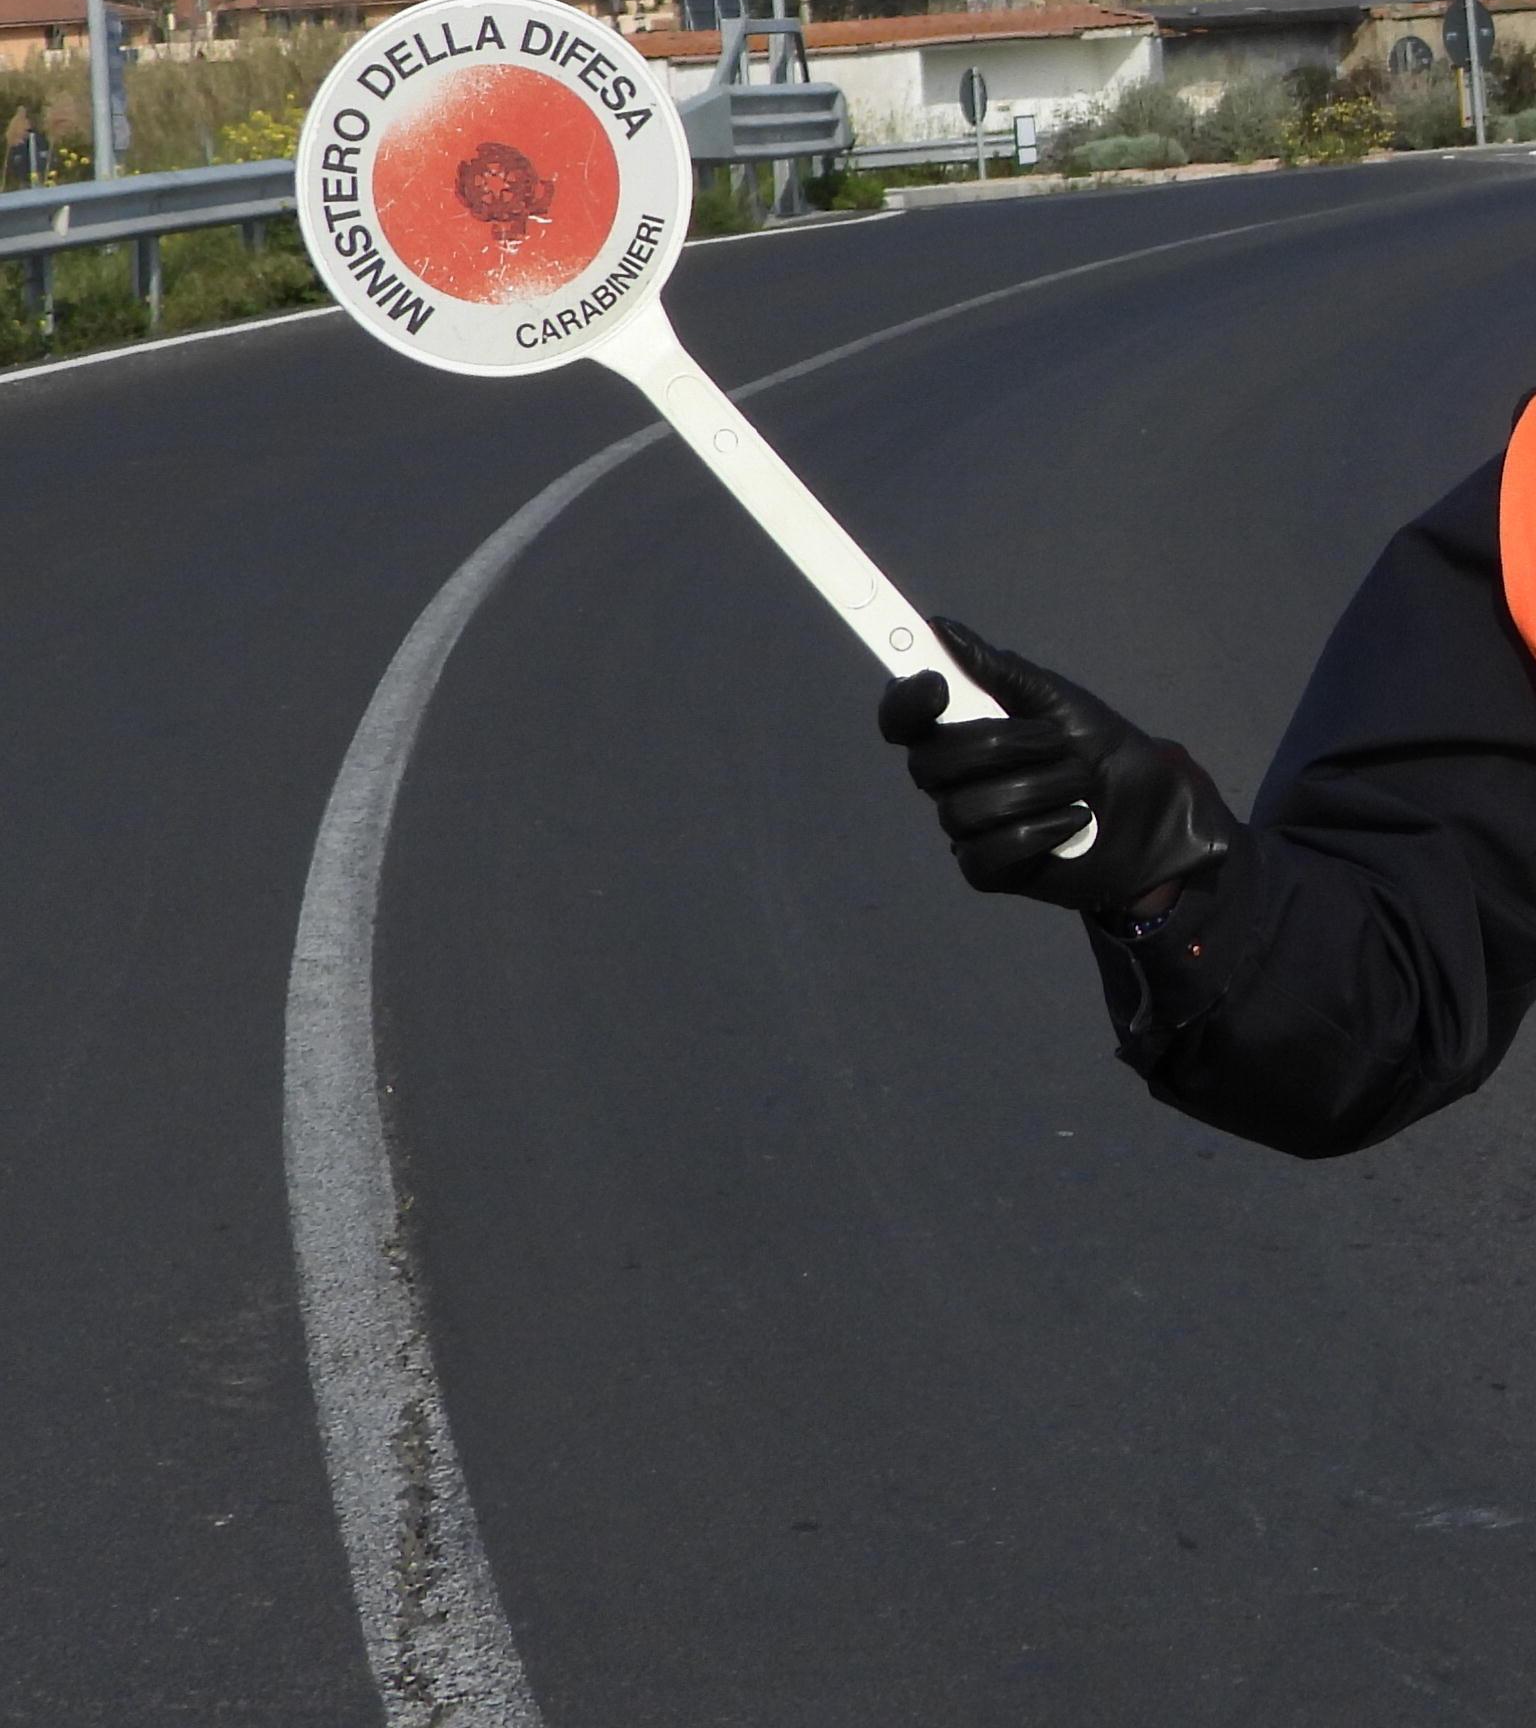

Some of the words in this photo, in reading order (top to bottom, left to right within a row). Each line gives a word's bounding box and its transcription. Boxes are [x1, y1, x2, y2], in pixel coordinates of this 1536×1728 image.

[357, 15, 506, 100] DELLA
[520, 19, 654, 139] DIFESA
[322, 108, 435, 336] MINISTERO
[515, 213, 665, 349] CARABINIERI
